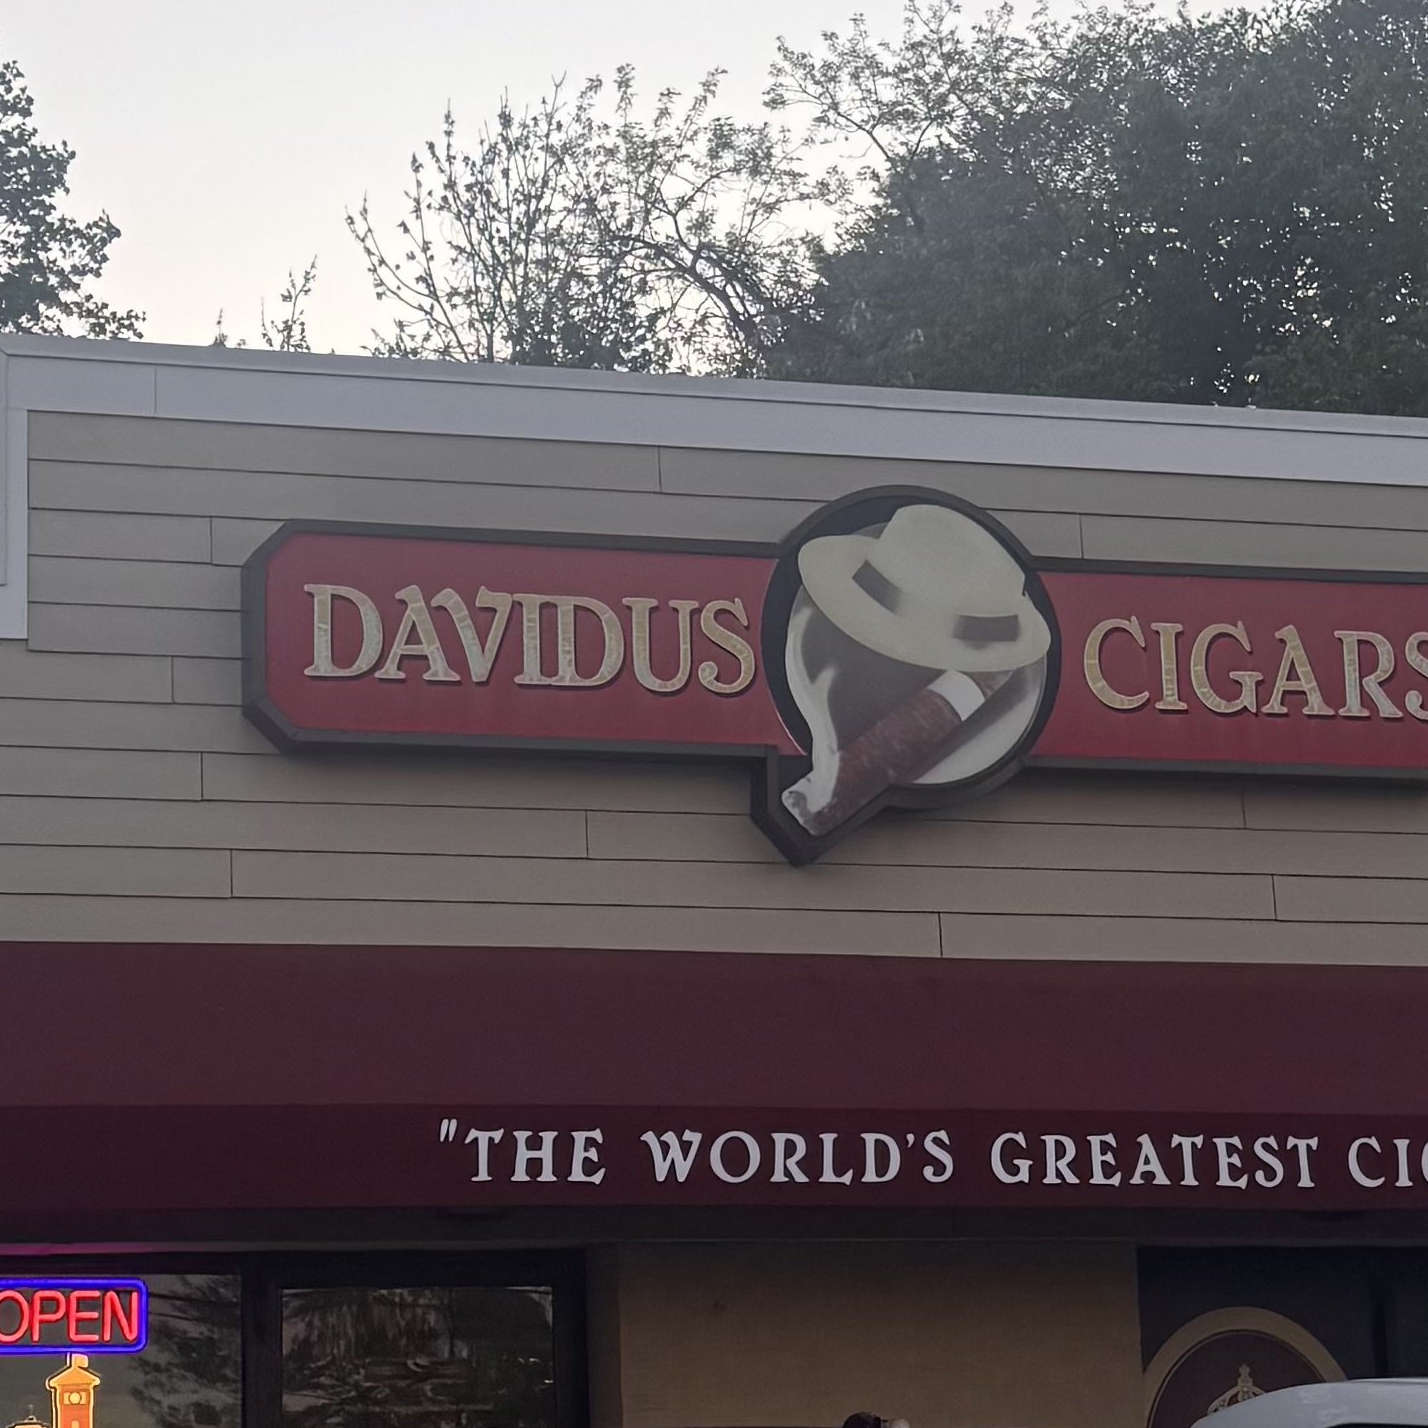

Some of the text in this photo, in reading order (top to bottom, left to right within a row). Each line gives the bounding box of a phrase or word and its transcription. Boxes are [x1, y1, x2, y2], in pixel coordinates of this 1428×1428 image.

[303, 584, 756, 694] DAVIDUS
[438, 1118, 606, 1185] "THE
[640, 1129, 954, 1186] WORLD'S
[990, 1131, 1319, 1189] GREATEST
